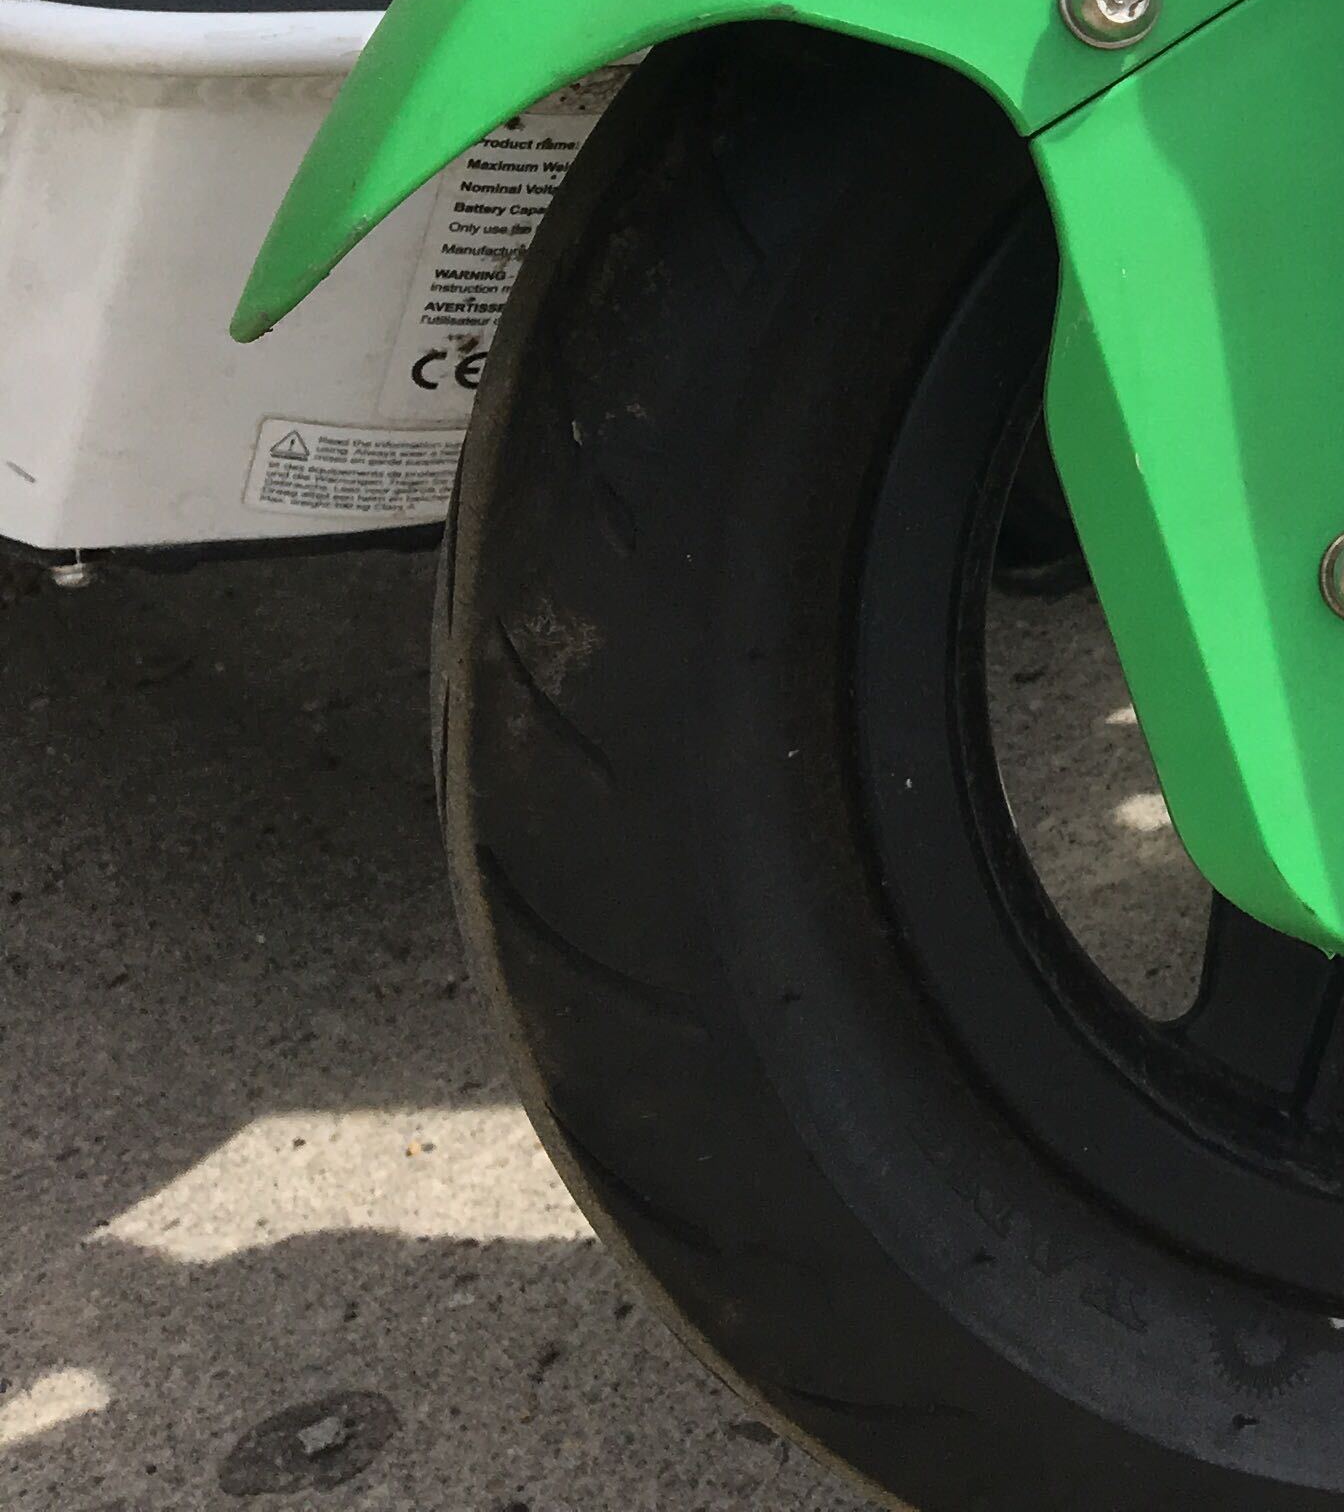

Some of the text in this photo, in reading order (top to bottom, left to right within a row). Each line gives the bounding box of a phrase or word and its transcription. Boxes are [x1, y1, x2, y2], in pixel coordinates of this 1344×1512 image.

[467, 158, 539, 172] Maximum
[460, 181, 522, 194] Nominal
[453, 202, 506, 216] Battery
[448, 222, 480, 235] Only
[483, 226, 507, 234] use
[435, 269, 506, 280] WARNING
